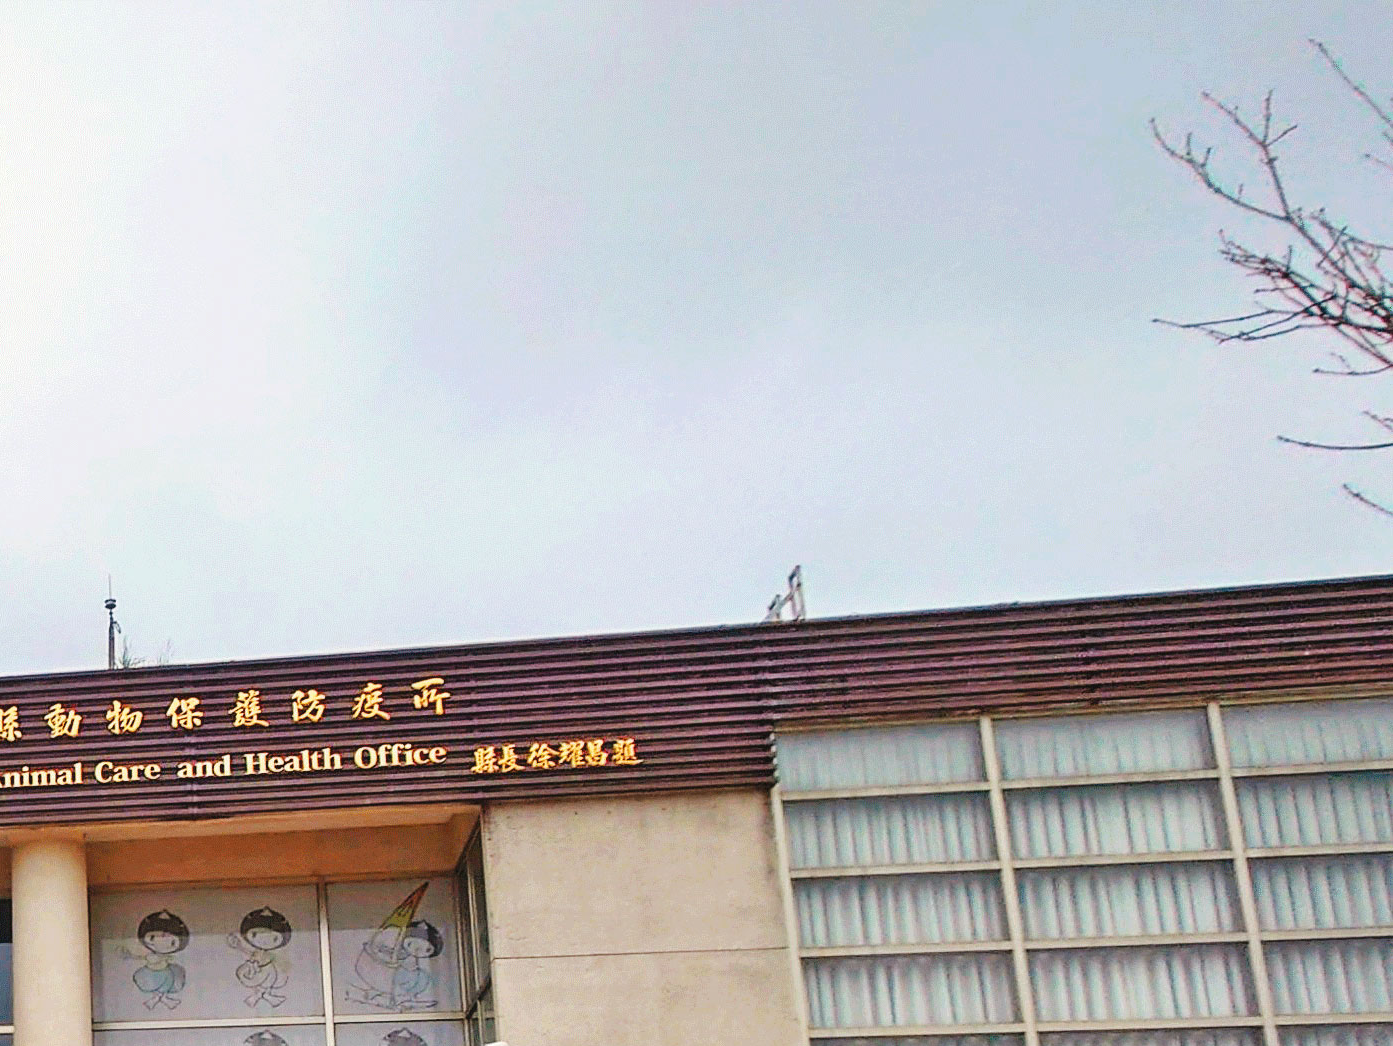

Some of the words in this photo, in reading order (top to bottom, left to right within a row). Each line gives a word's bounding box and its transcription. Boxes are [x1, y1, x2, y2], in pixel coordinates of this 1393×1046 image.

[94, 758, 161, 784] Care
[176, 753, 232, 779] and
[242, 746, 343, 776] Health
[353, 742, 447, 770] Office
